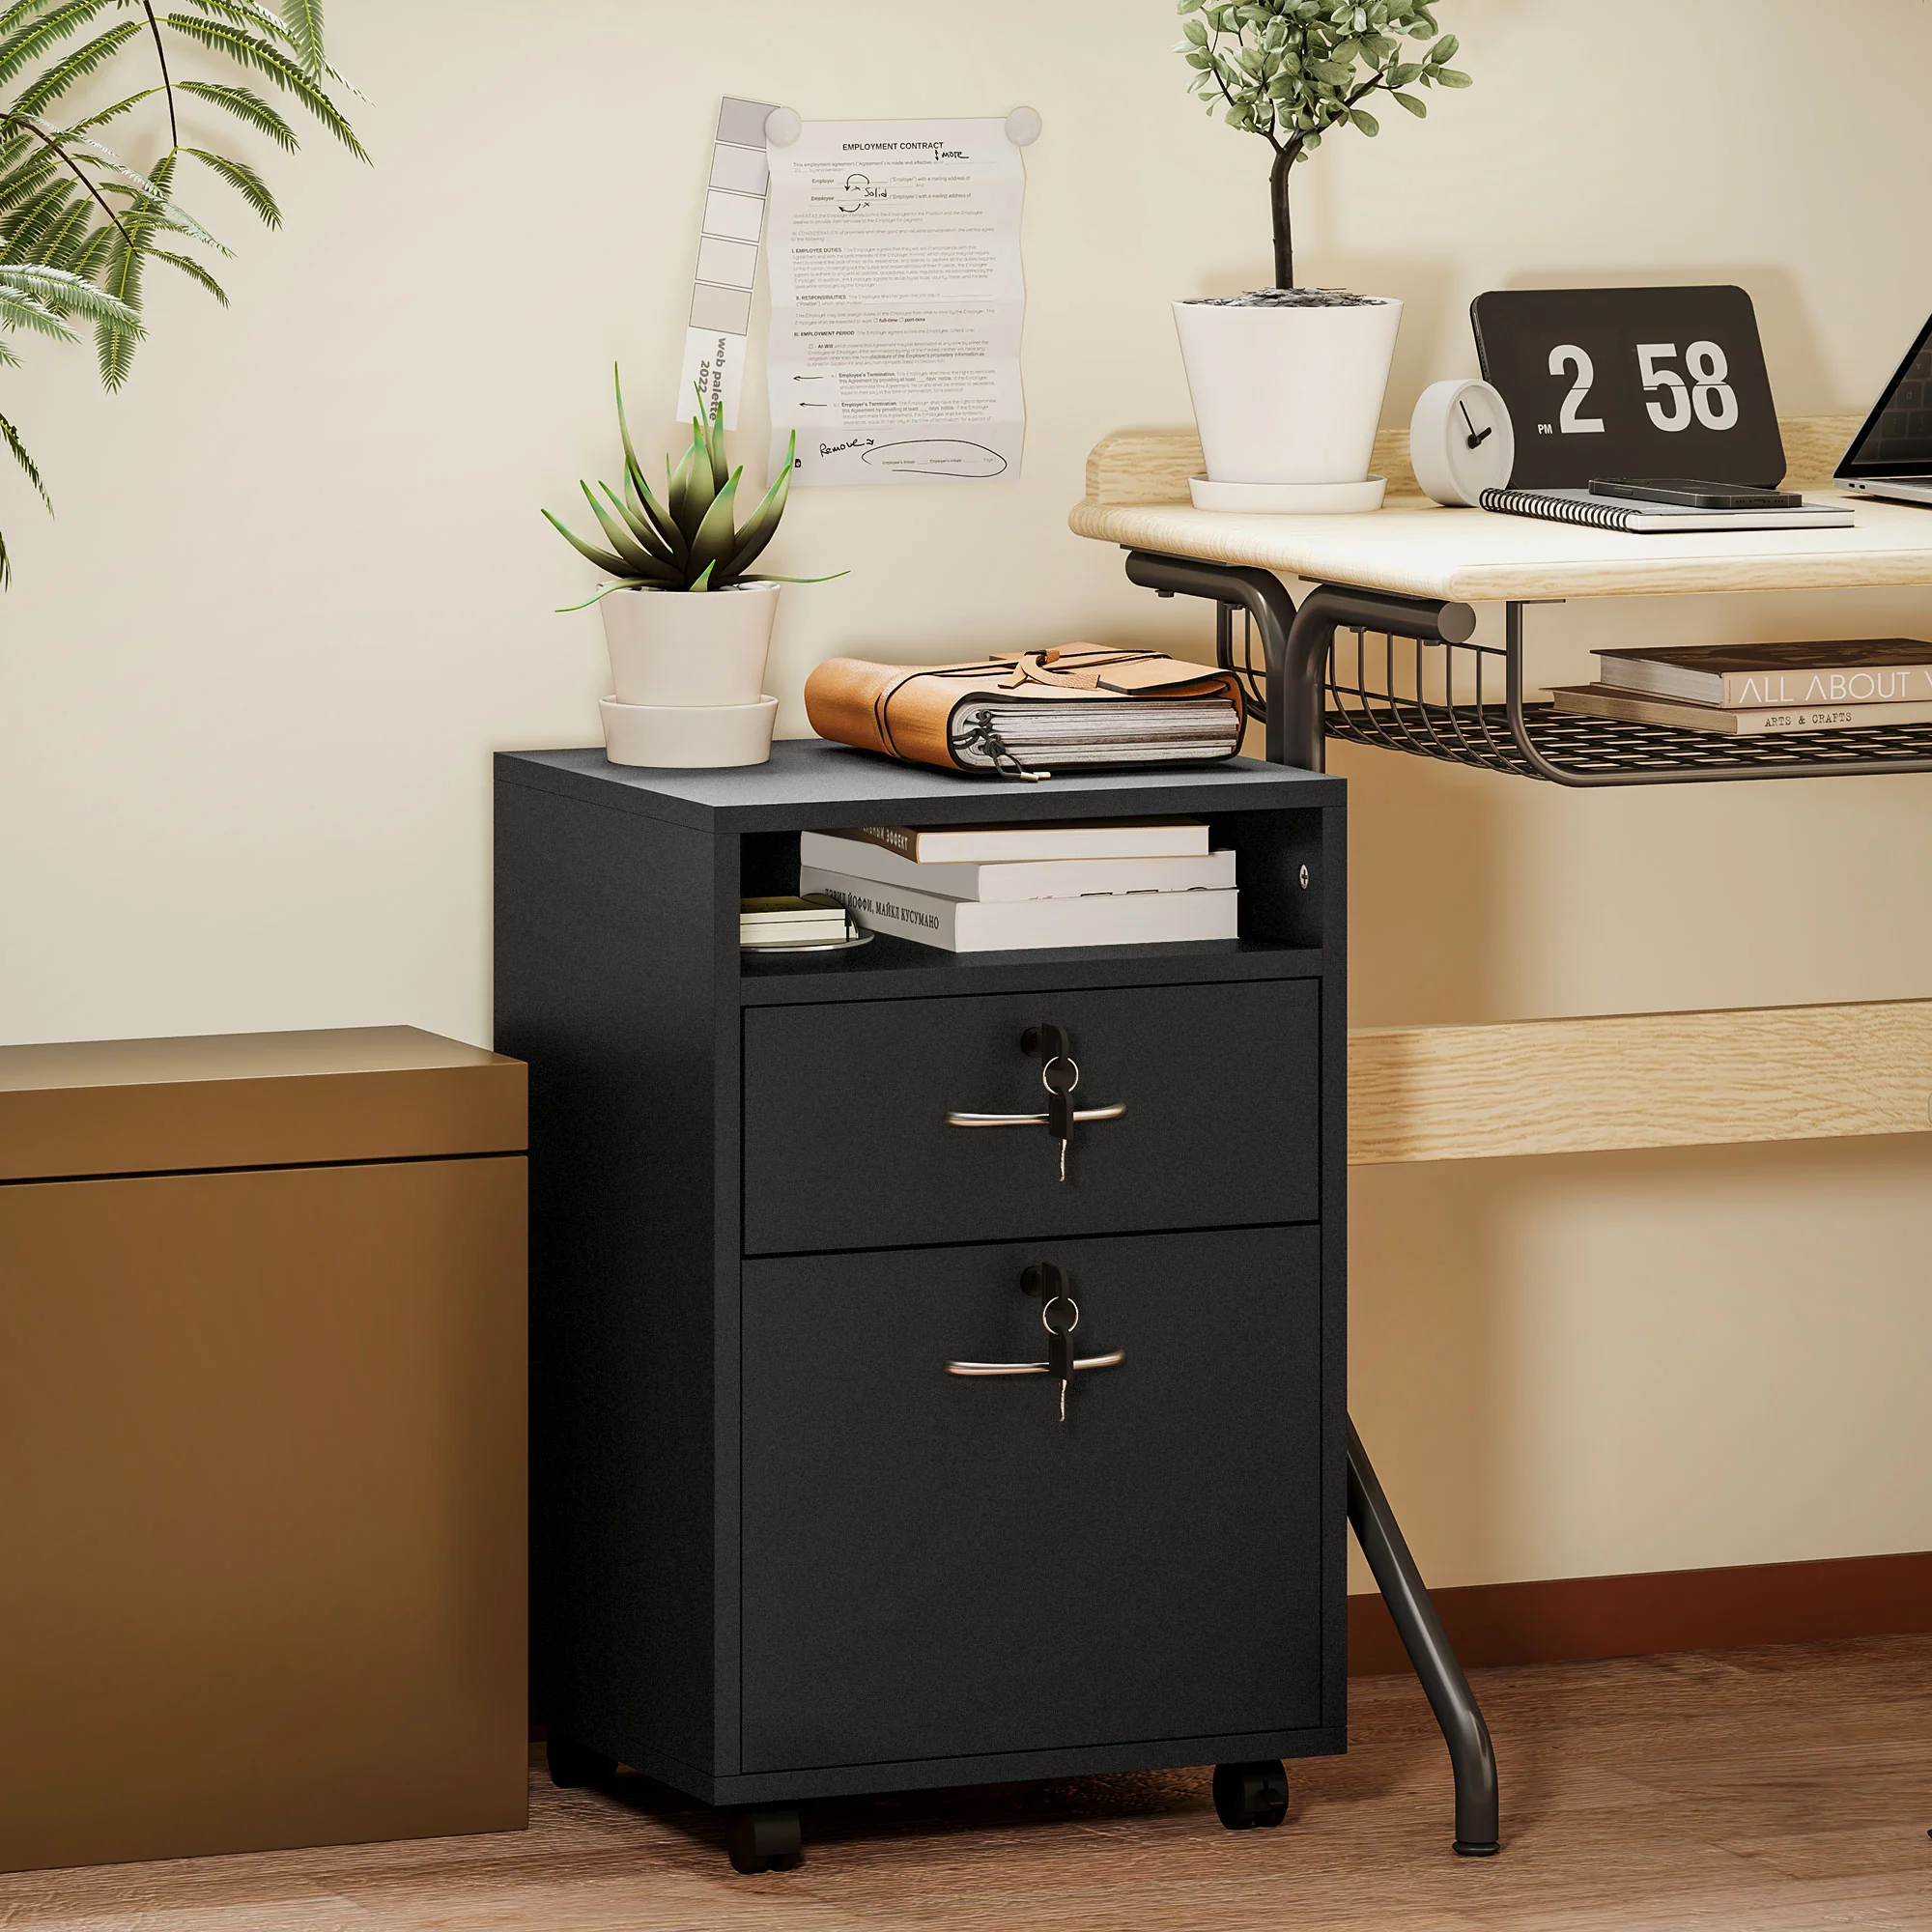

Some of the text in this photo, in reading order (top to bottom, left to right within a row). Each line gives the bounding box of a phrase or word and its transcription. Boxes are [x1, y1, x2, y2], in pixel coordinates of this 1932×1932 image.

[842, 141, 944, 151] EMPLOYMENT CONTRACT
[717, 337, 726, 368] web
[698, 359, 710, 393] 2022
[1548, 340, 1739, 434] 2 58
[1537, 423, 1553, 435] PM
[1738, 676, 1795, 704] ALL
[1804, 671, 1911, 701] ABOUT
[1765, 712, 1853, 727] ARTS & CRAFTS
[876, 901, 900, 919] МАЙКЛ
[900, 908, 940, 930] КУСУМАНО
